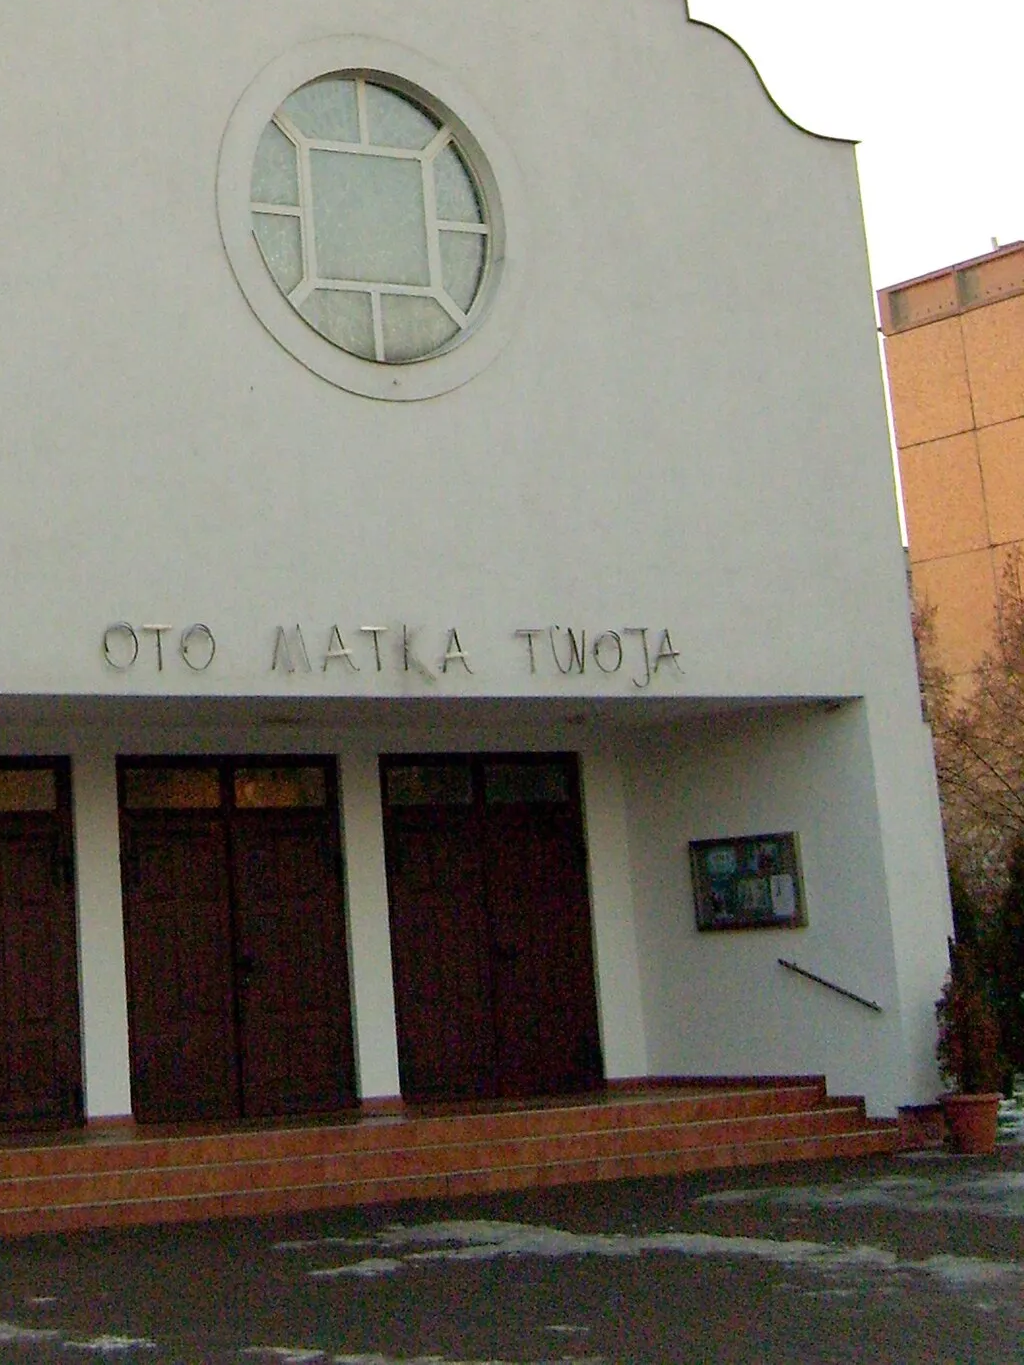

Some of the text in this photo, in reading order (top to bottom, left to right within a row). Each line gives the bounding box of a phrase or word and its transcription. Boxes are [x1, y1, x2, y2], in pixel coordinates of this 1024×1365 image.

[102, 621, 685, 688] OTO MATKA TWOJA
